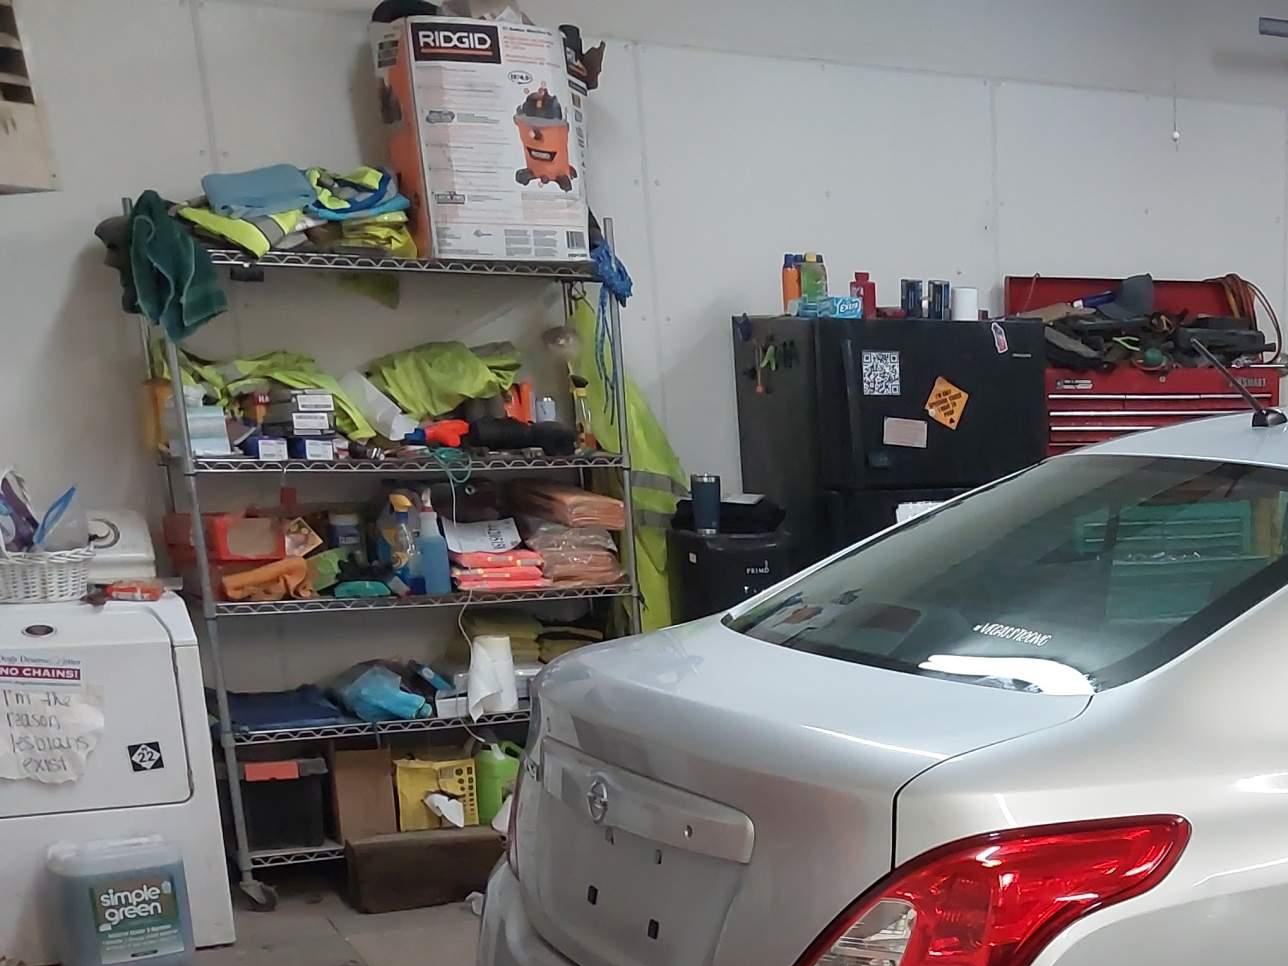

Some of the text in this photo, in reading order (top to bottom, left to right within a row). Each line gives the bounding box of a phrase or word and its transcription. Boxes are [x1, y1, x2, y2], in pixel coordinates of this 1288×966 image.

[417, 30, 492, 50] RIDGID
[0, 666, 79, 679] NO CHAINS!
[3, 689, 72, 707] I'm the
[7, 711, 61, 729] reason
[23, 754, 69, 773] exist
[138, 752, 156, 764] 22
[100, 884, 161, 907] simple
[104, 901, 162, 925] green
